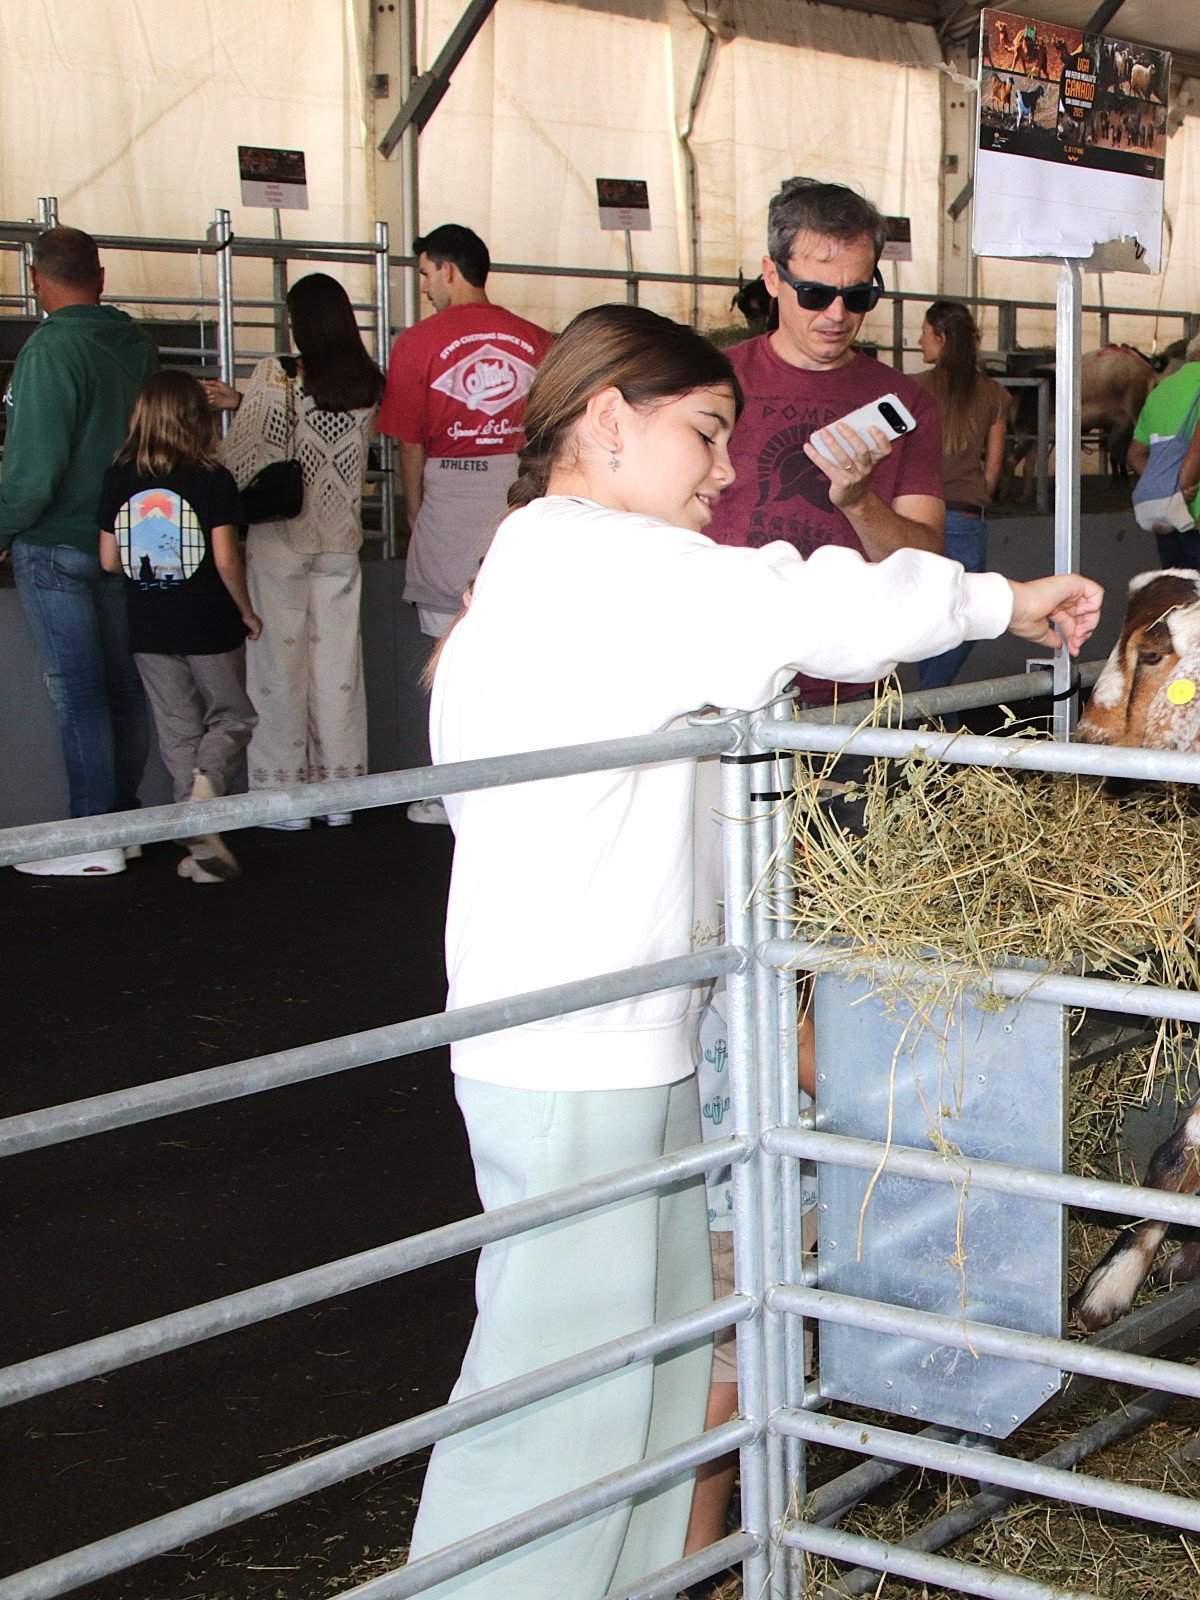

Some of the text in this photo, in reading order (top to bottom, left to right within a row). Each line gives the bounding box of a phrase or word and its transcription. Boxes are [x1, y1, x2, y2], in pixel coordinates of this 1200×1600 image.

[1065, 79, 1095, 101] GANADO
[762, 403, 838, 421] POMP
[439, 459, 488, 472] ATHLETES
